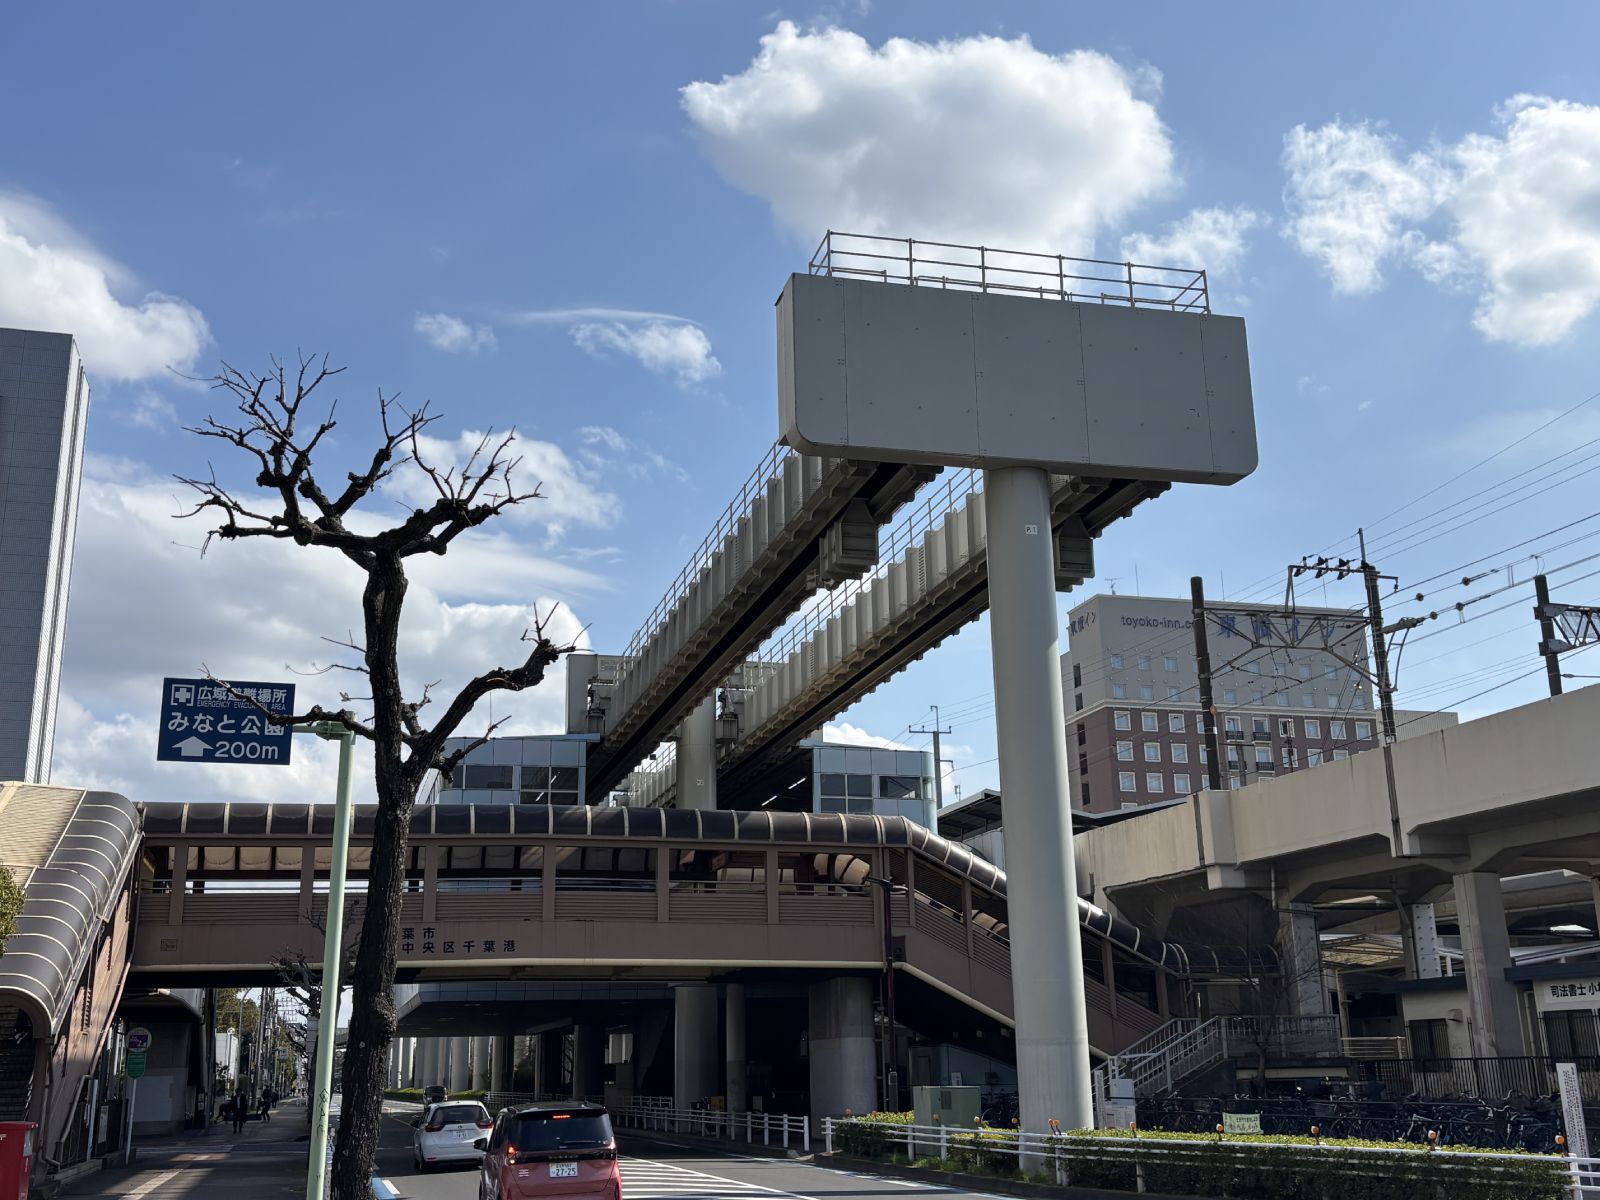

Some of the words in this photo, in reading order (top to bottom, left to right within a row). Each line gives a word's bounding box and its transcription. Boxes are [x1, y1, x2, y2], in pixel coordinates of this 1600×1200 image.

[1121, 615, 1191, 629] toyoko-inn.c
[197, 700, 230, 708] EMERGENCY
[271, 703, 286, 711] AREA
[215, 741, 278, 759] 200m
[1550, 983, 1587, 998] 司法書士
